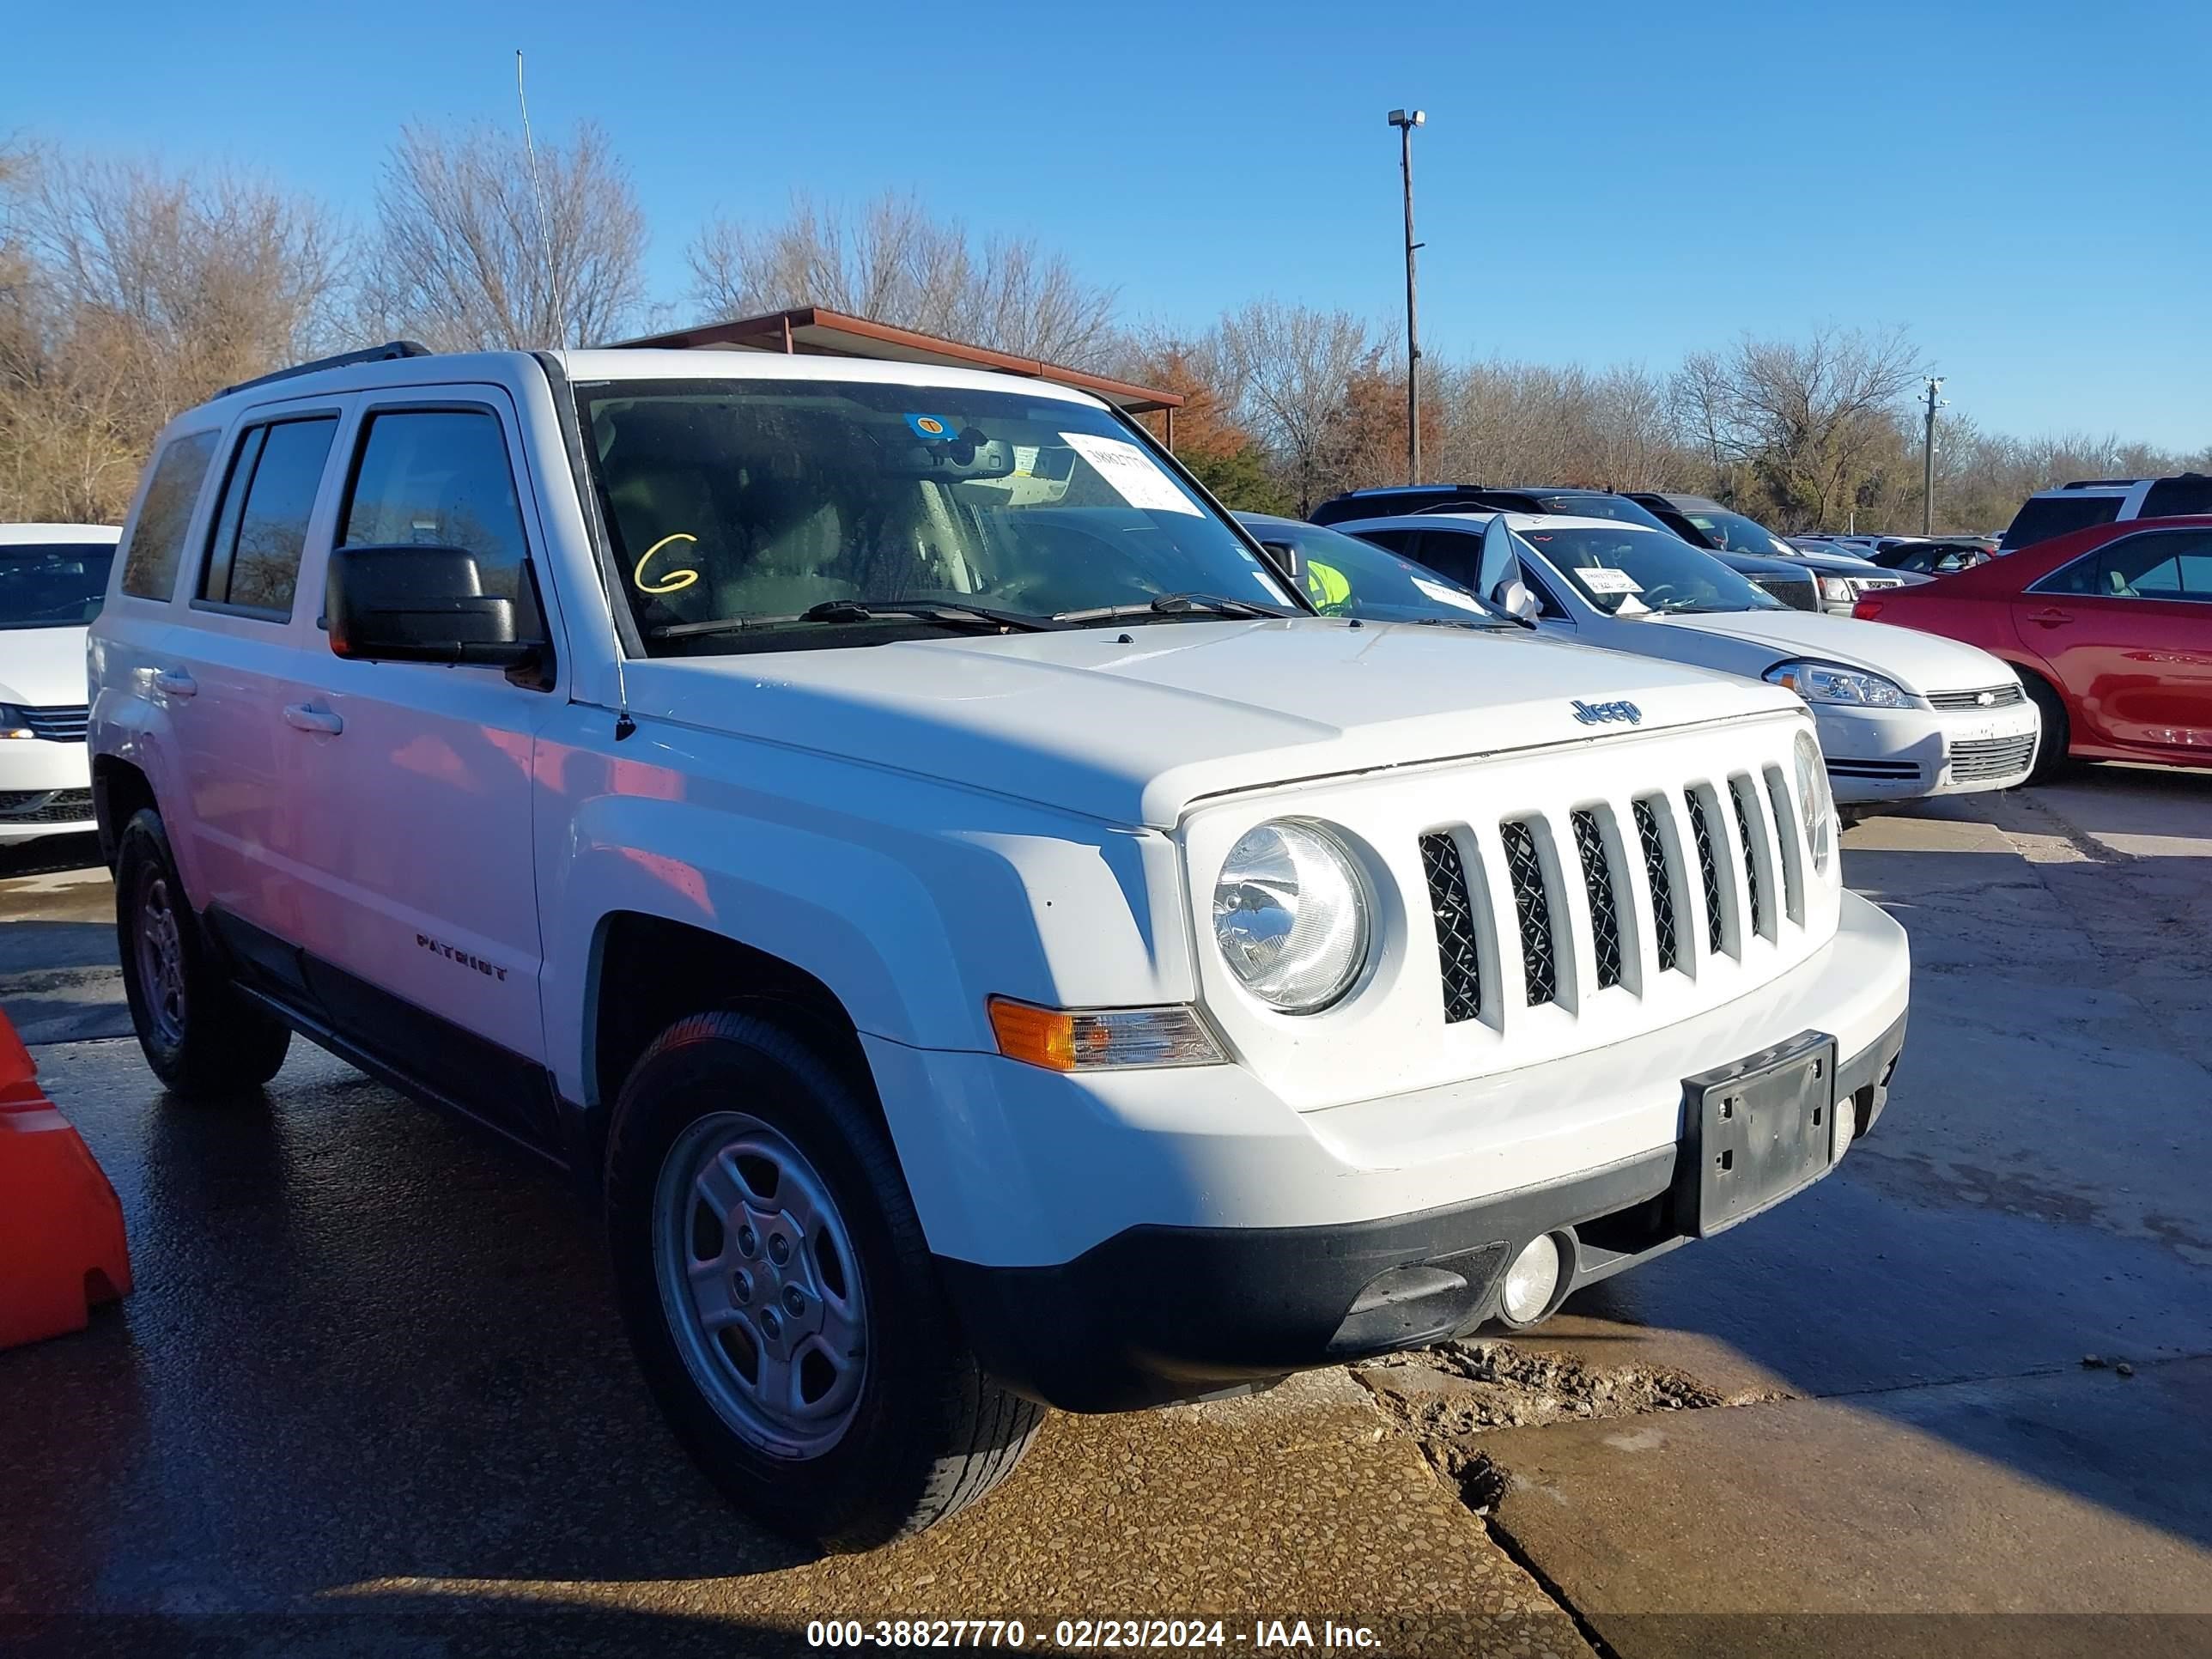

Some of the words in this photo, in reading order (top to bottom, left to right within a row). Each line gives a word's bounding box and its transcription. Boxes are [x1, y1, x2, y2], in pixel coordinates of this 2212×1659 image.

[634, 533, 699, 593] 6
[1569, 700, 1643, 726] Jeep
[416, 933, 507, 981] PATRIOT
